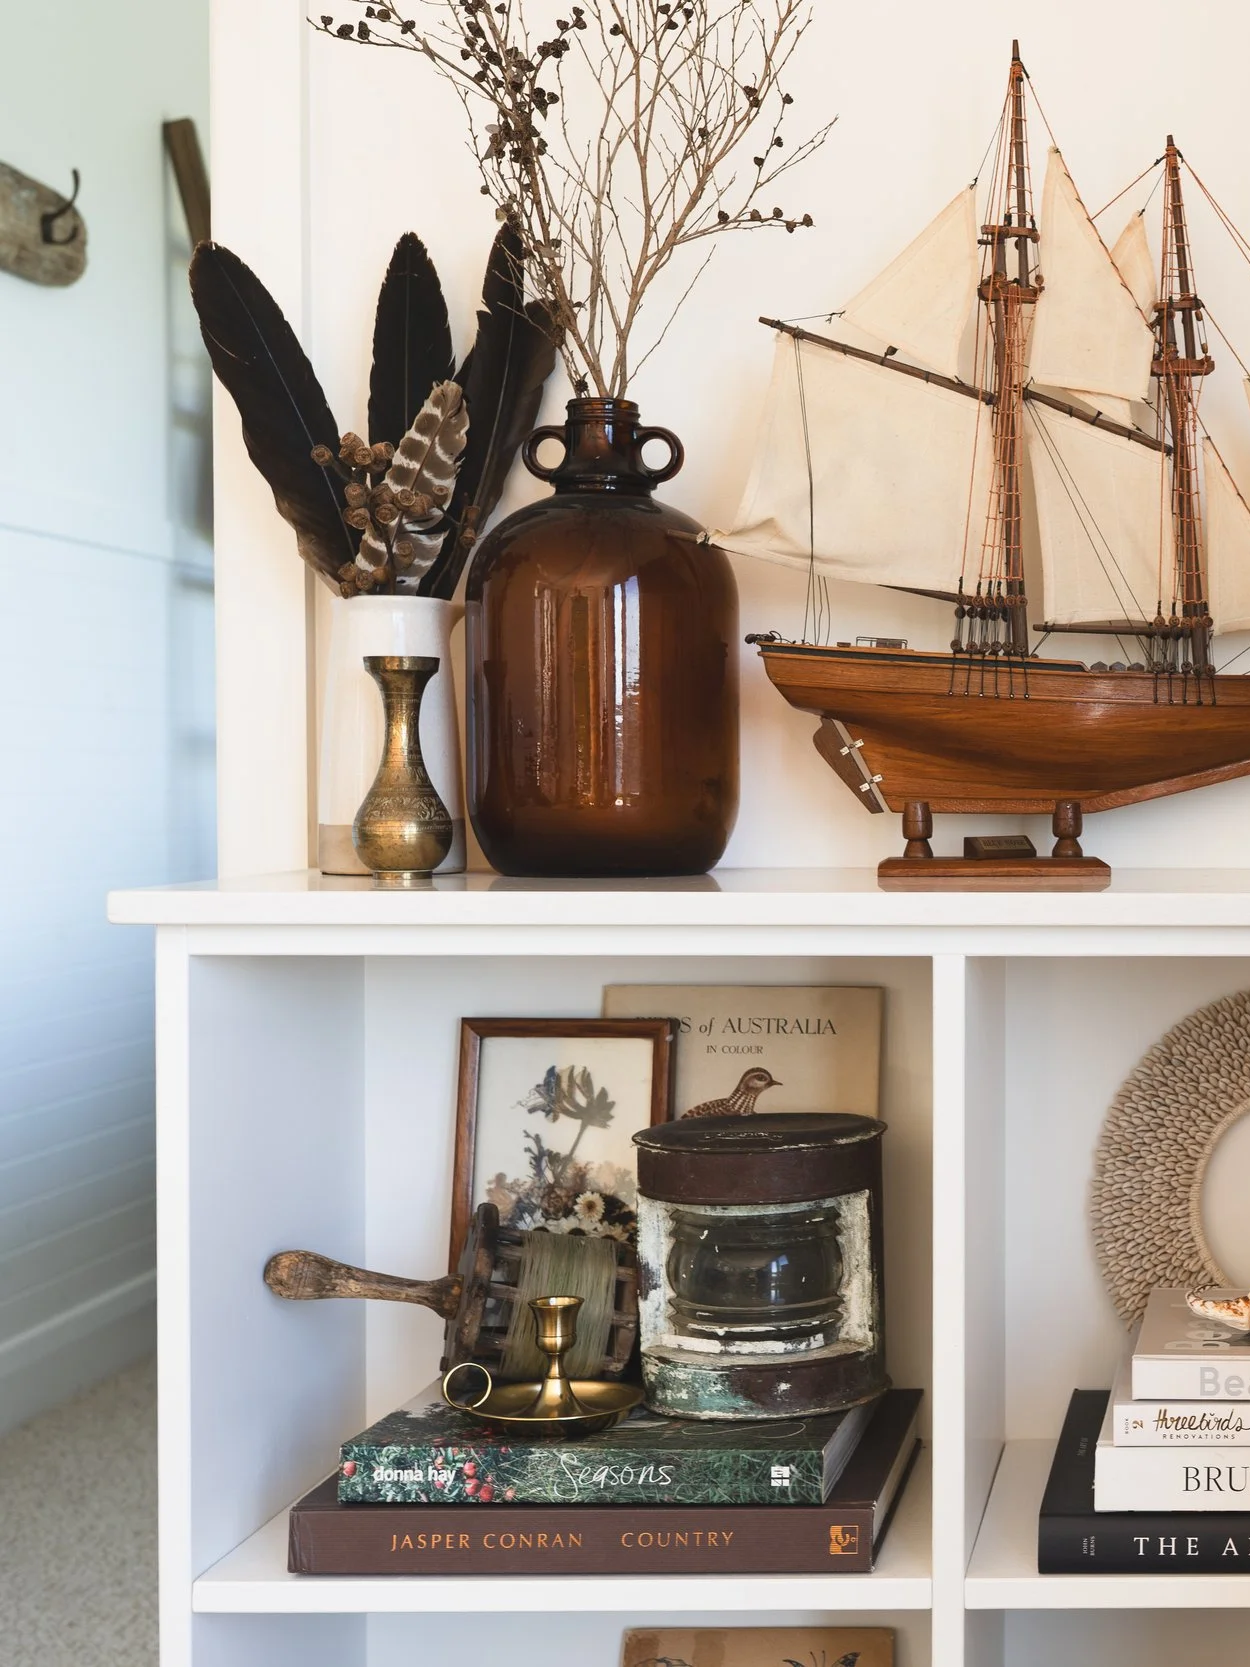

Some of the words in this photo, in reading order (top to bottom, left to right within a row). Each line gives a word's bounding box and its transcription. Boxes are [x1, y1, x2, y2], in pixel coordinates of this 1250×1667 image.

[698, 1017, 715, 1037] of
[721, 1017, 837, 1035] AUSTRALIA
[706, 1045, 717, 1054] IN
[721, 1044, 764, 1055] COLOUR
[1132, 1419, 1144, 1429] 2
[373, 1465, 423, 1482] donna
[427, 1465, 457, 1485] hay
[554, 1453, 675, 1498] Seasons
[391, 1532, 471, 1552] JASPER
[483, 1532, 583, 1550] CONRAN
[621, 1530, 735, 1549] COUNTRY
[1133, 1536, 1199, 1557] THE
